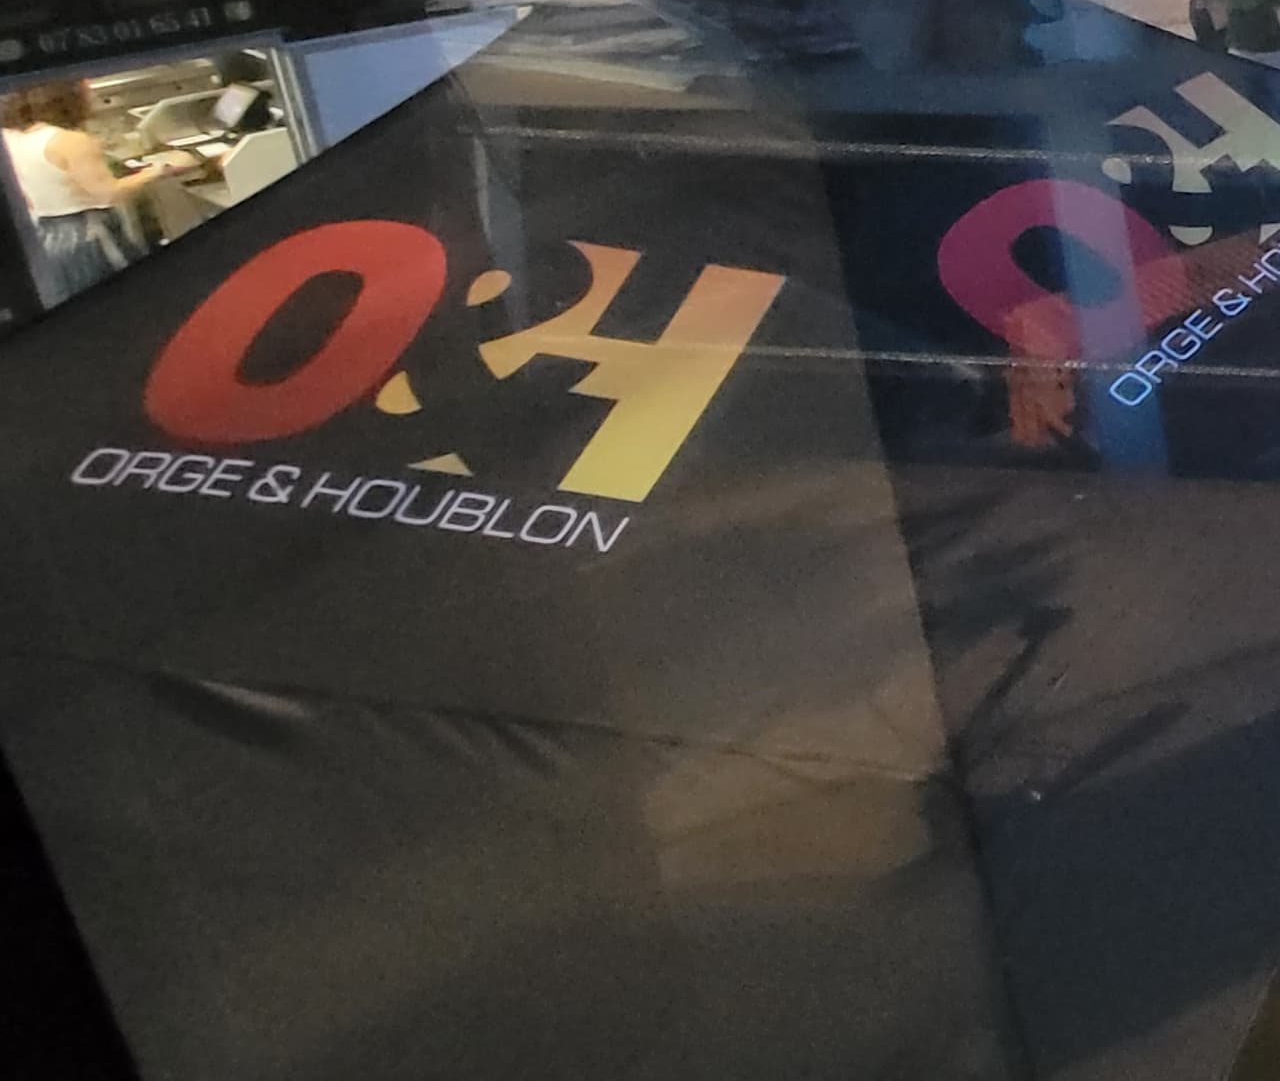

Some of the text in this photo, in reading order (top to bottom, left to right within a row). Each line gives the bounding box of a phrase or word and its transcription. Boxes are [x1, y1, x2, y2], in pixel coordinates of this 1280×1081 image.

[1109, 308, 1224, 406] ORGE
[1211, 287, 1253, 316] &
[71, 448, 630, 553] ORGE & HOUBLON
